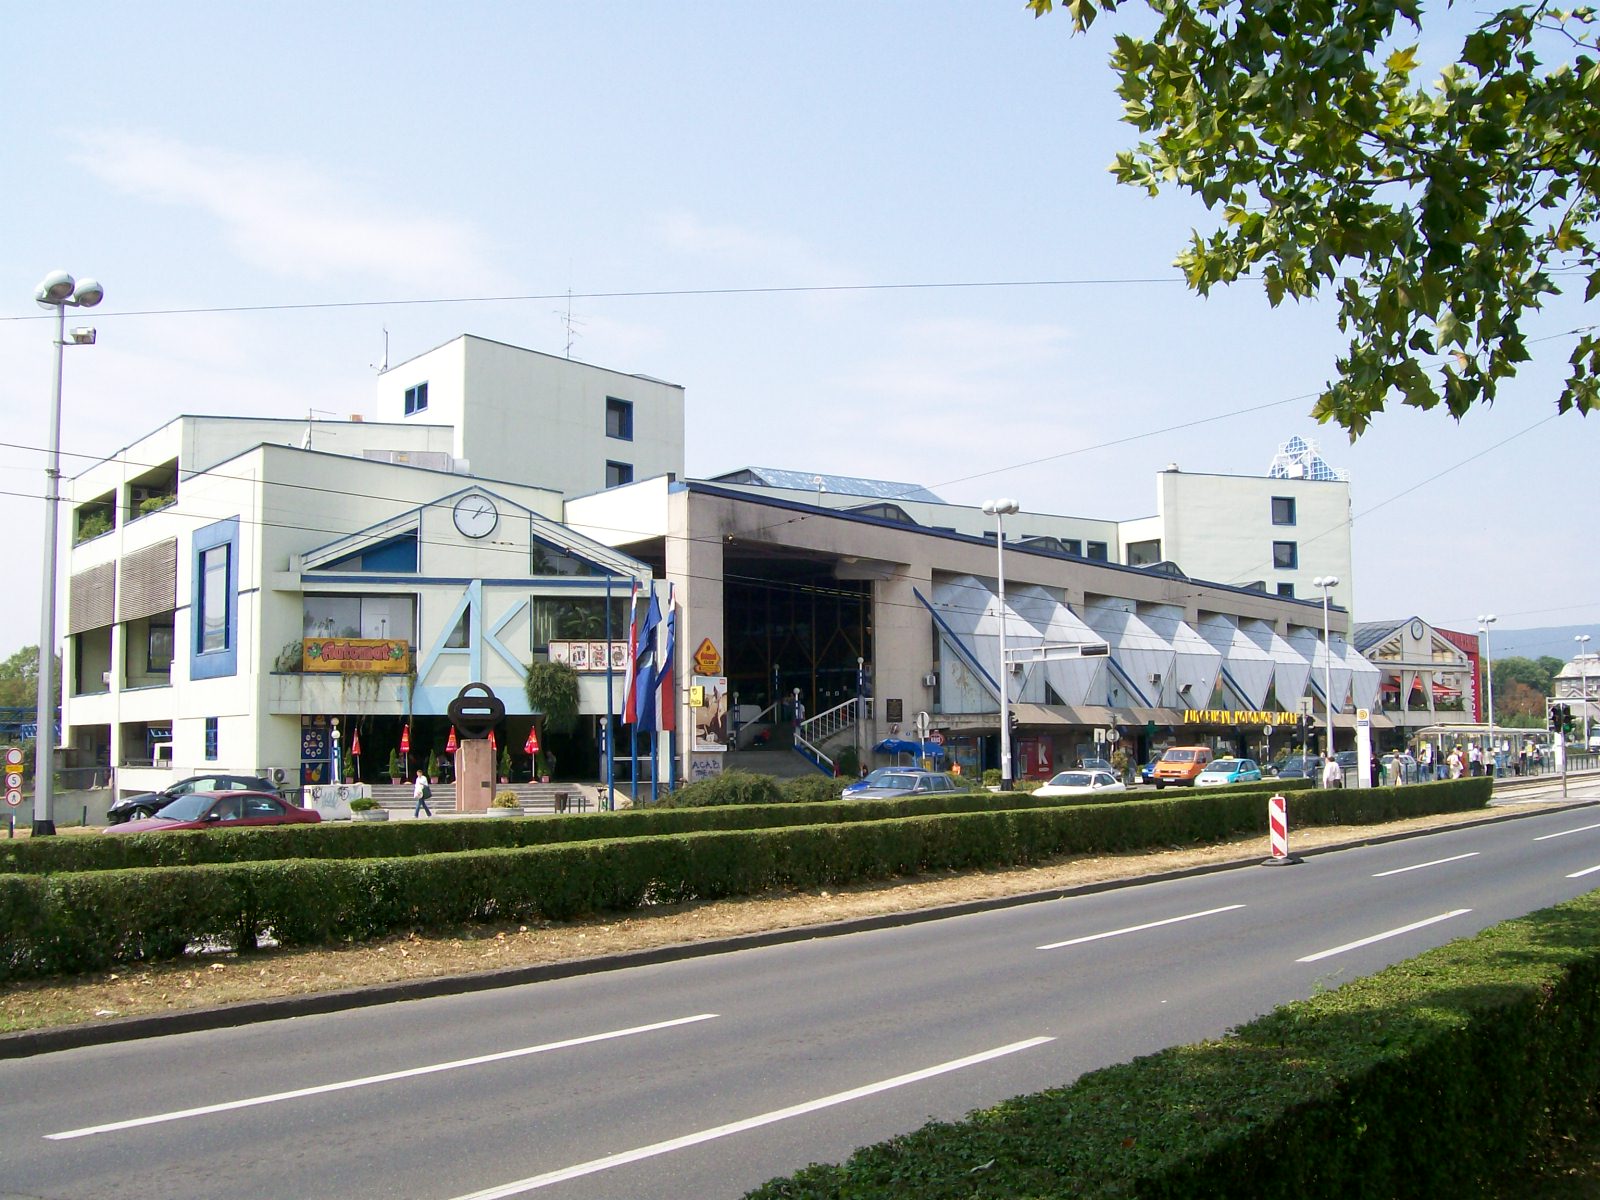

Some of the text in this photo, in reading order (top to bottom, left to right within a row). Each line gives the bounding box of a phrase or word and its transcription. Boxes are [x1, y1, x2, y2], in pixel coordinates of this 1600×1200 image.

[413, 579, 530, 688] AK
[322, 641, 390, 662] Automat
[340, 661, 372, 669] CLUB
[1038, 743, 1049, 765] K
[12, 777, 17, 785] 5
